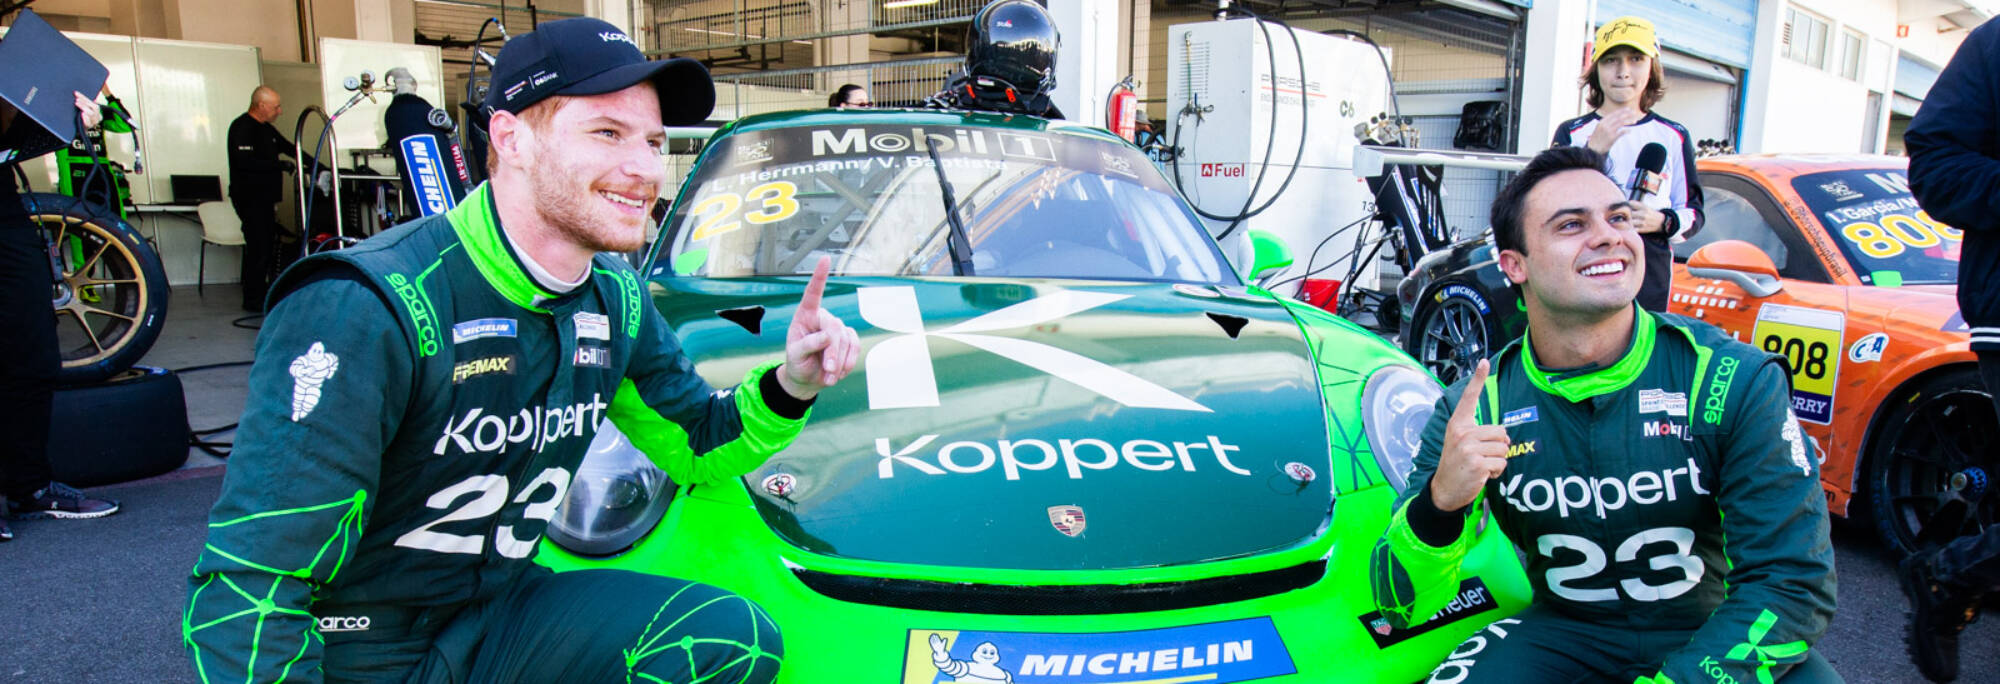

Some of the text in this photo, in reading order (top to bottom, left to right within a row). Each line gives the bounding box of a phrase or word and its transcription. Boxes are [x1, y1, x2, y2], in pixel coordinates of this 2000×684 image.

[1340, 100, 1354, 118] C6
[812, 128, 988, 156] Mobil
[1214, 163, 1245, 177] Fuel
[693, 181, 800, 243] 23
[389, 272, 438, 356] sparco
[621, 269, 641, 340] sparco
[1449, 285, 1487, 312] MICHELIN
[462, 324, 509, 336] MICHELIN
[452, 357, 510, 382] FREMAX
[1703, 356, 1736, 424] sparco
[433, 392, 607, 455] Koppert
[875, 433, 1251, 480] Koppert
[1500, 457, 1710, 520] Koppert
[394, 466, 571, 559] 23
[1537, 527, 1705, 602] 23
[317, 616, 371, 629] arco
[1019, 640, 1253, 677] MICHELIN
[1699, 655, 1738, 684] Kop
